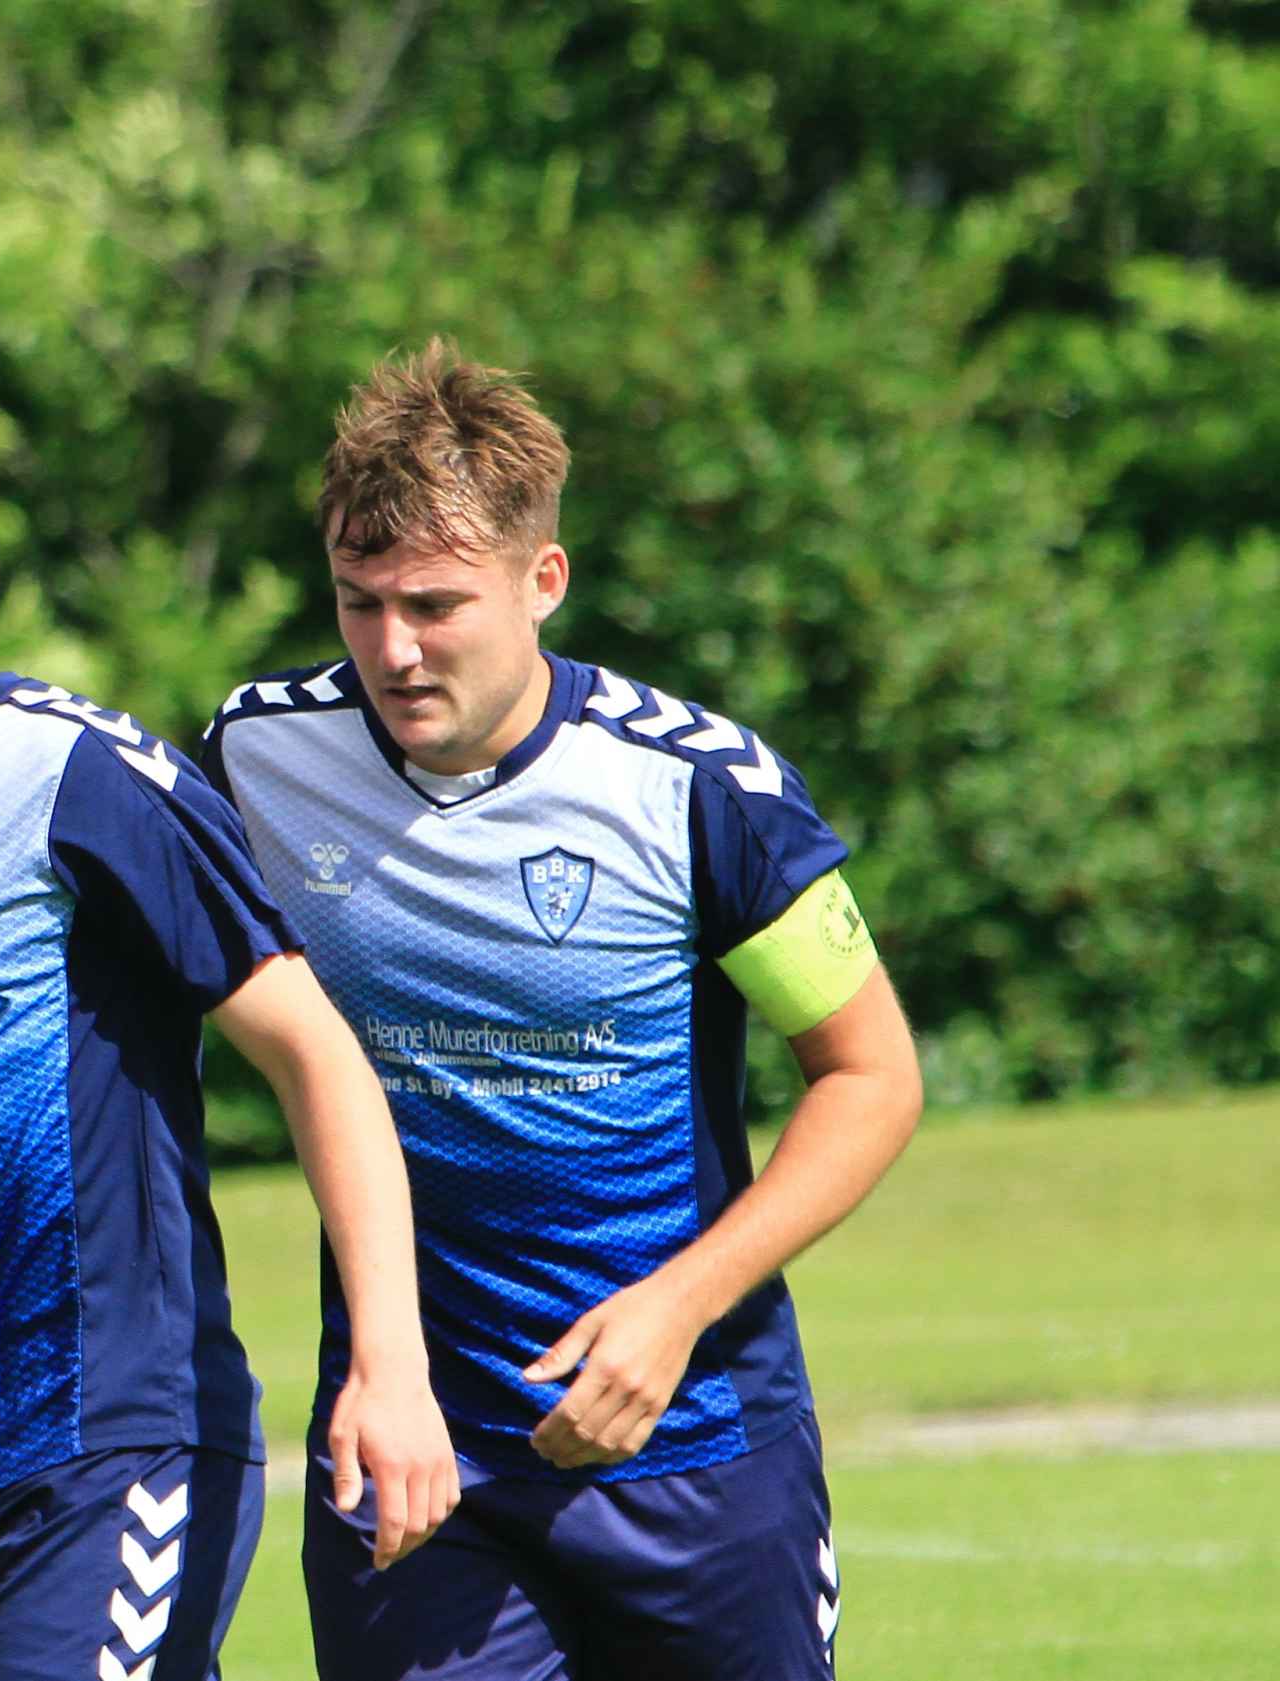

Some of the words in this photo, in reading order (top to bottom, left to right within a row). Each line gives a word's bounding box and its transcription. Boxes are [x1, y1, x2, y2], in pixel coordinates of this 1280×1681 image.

[531, 858, 586, 884] BBK
[304, 877, 352, 897] hummel
[365, 1016, 425, 1049] Henne
[429, 1020, 580, 1057] Murerforretning
[583, 1018, 617, 1051] A/S
[431, 1080, 453, 1100] By
